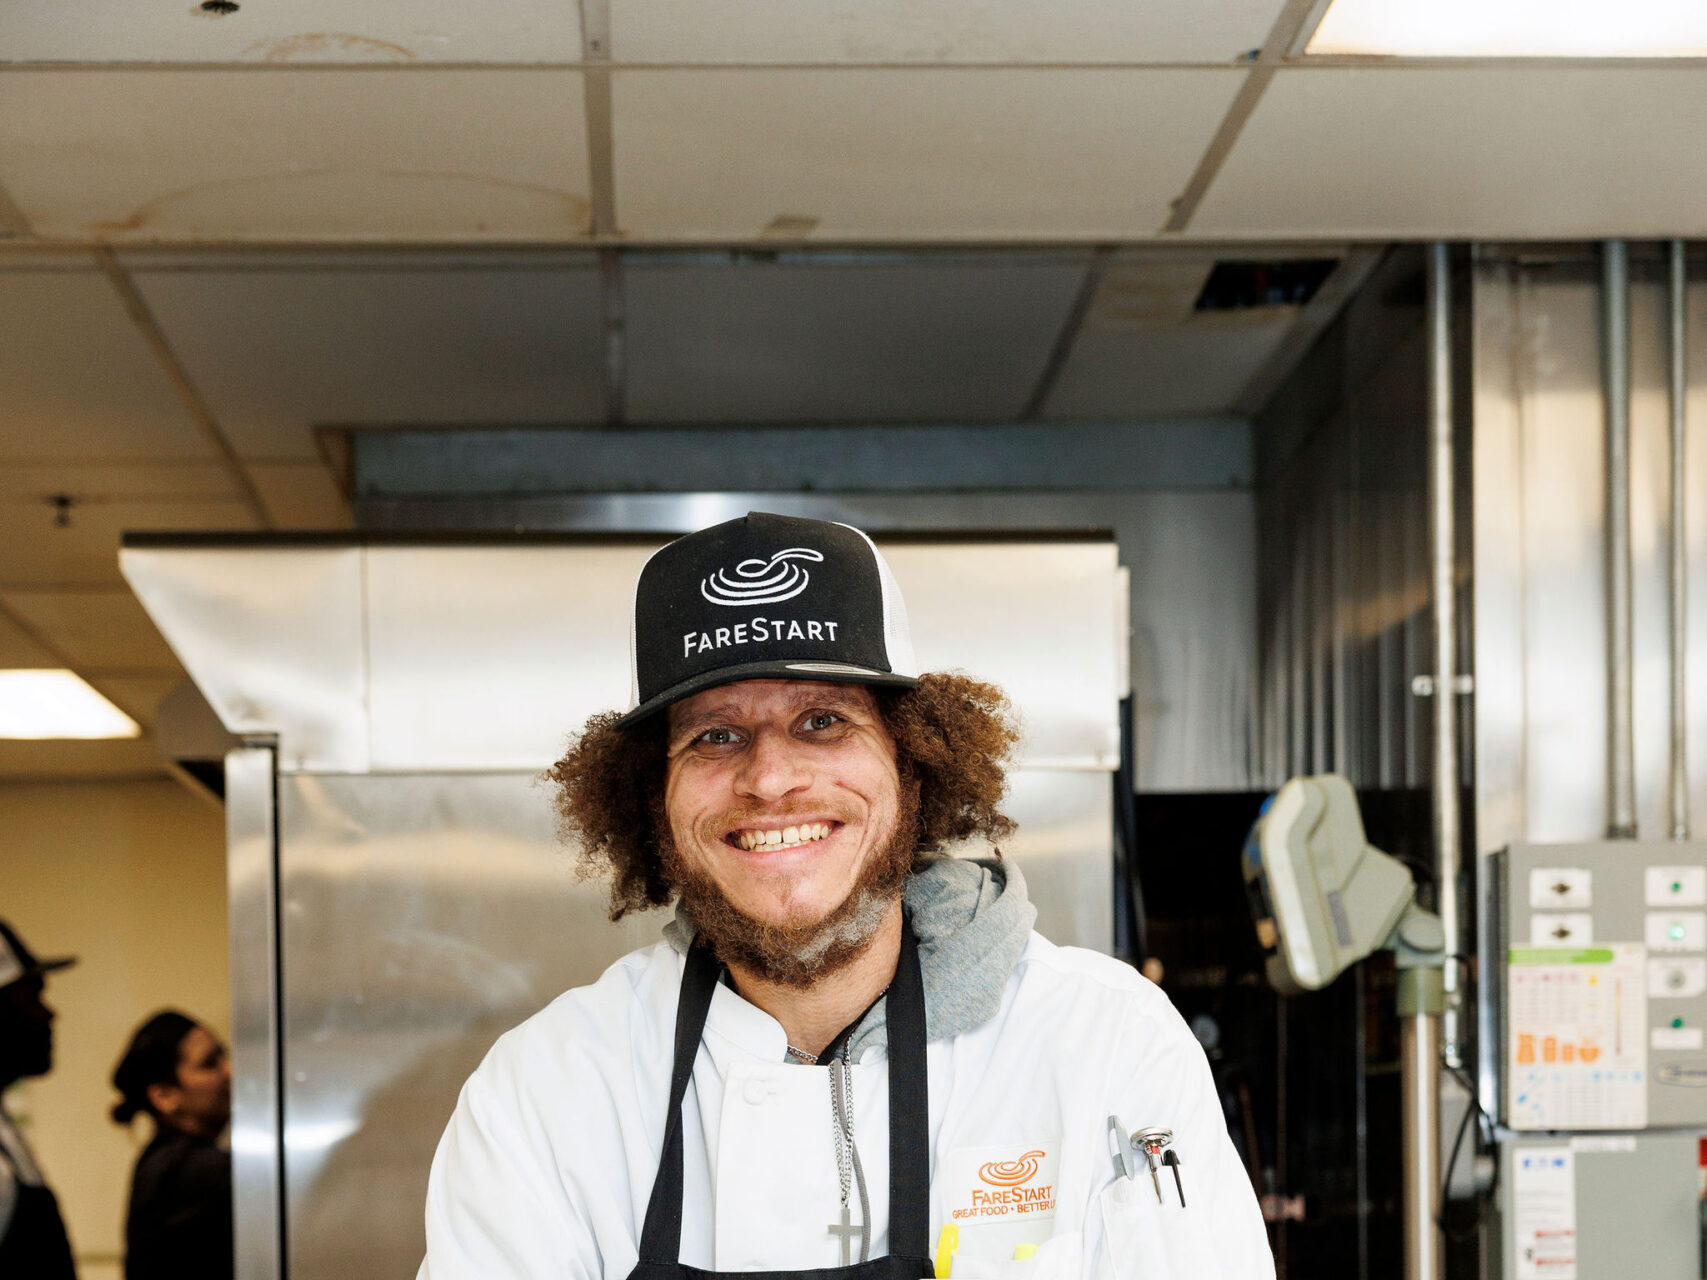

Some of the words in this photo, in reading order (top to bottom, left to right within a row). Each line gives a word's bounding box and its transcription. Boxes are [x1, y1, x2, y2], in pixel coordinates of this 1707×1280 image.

[952, 1207, 979, 1219] GREAT
[980, 1205, 1009, 1217] FOOD
[1016, 1200, 1049, 1214] BETTER
